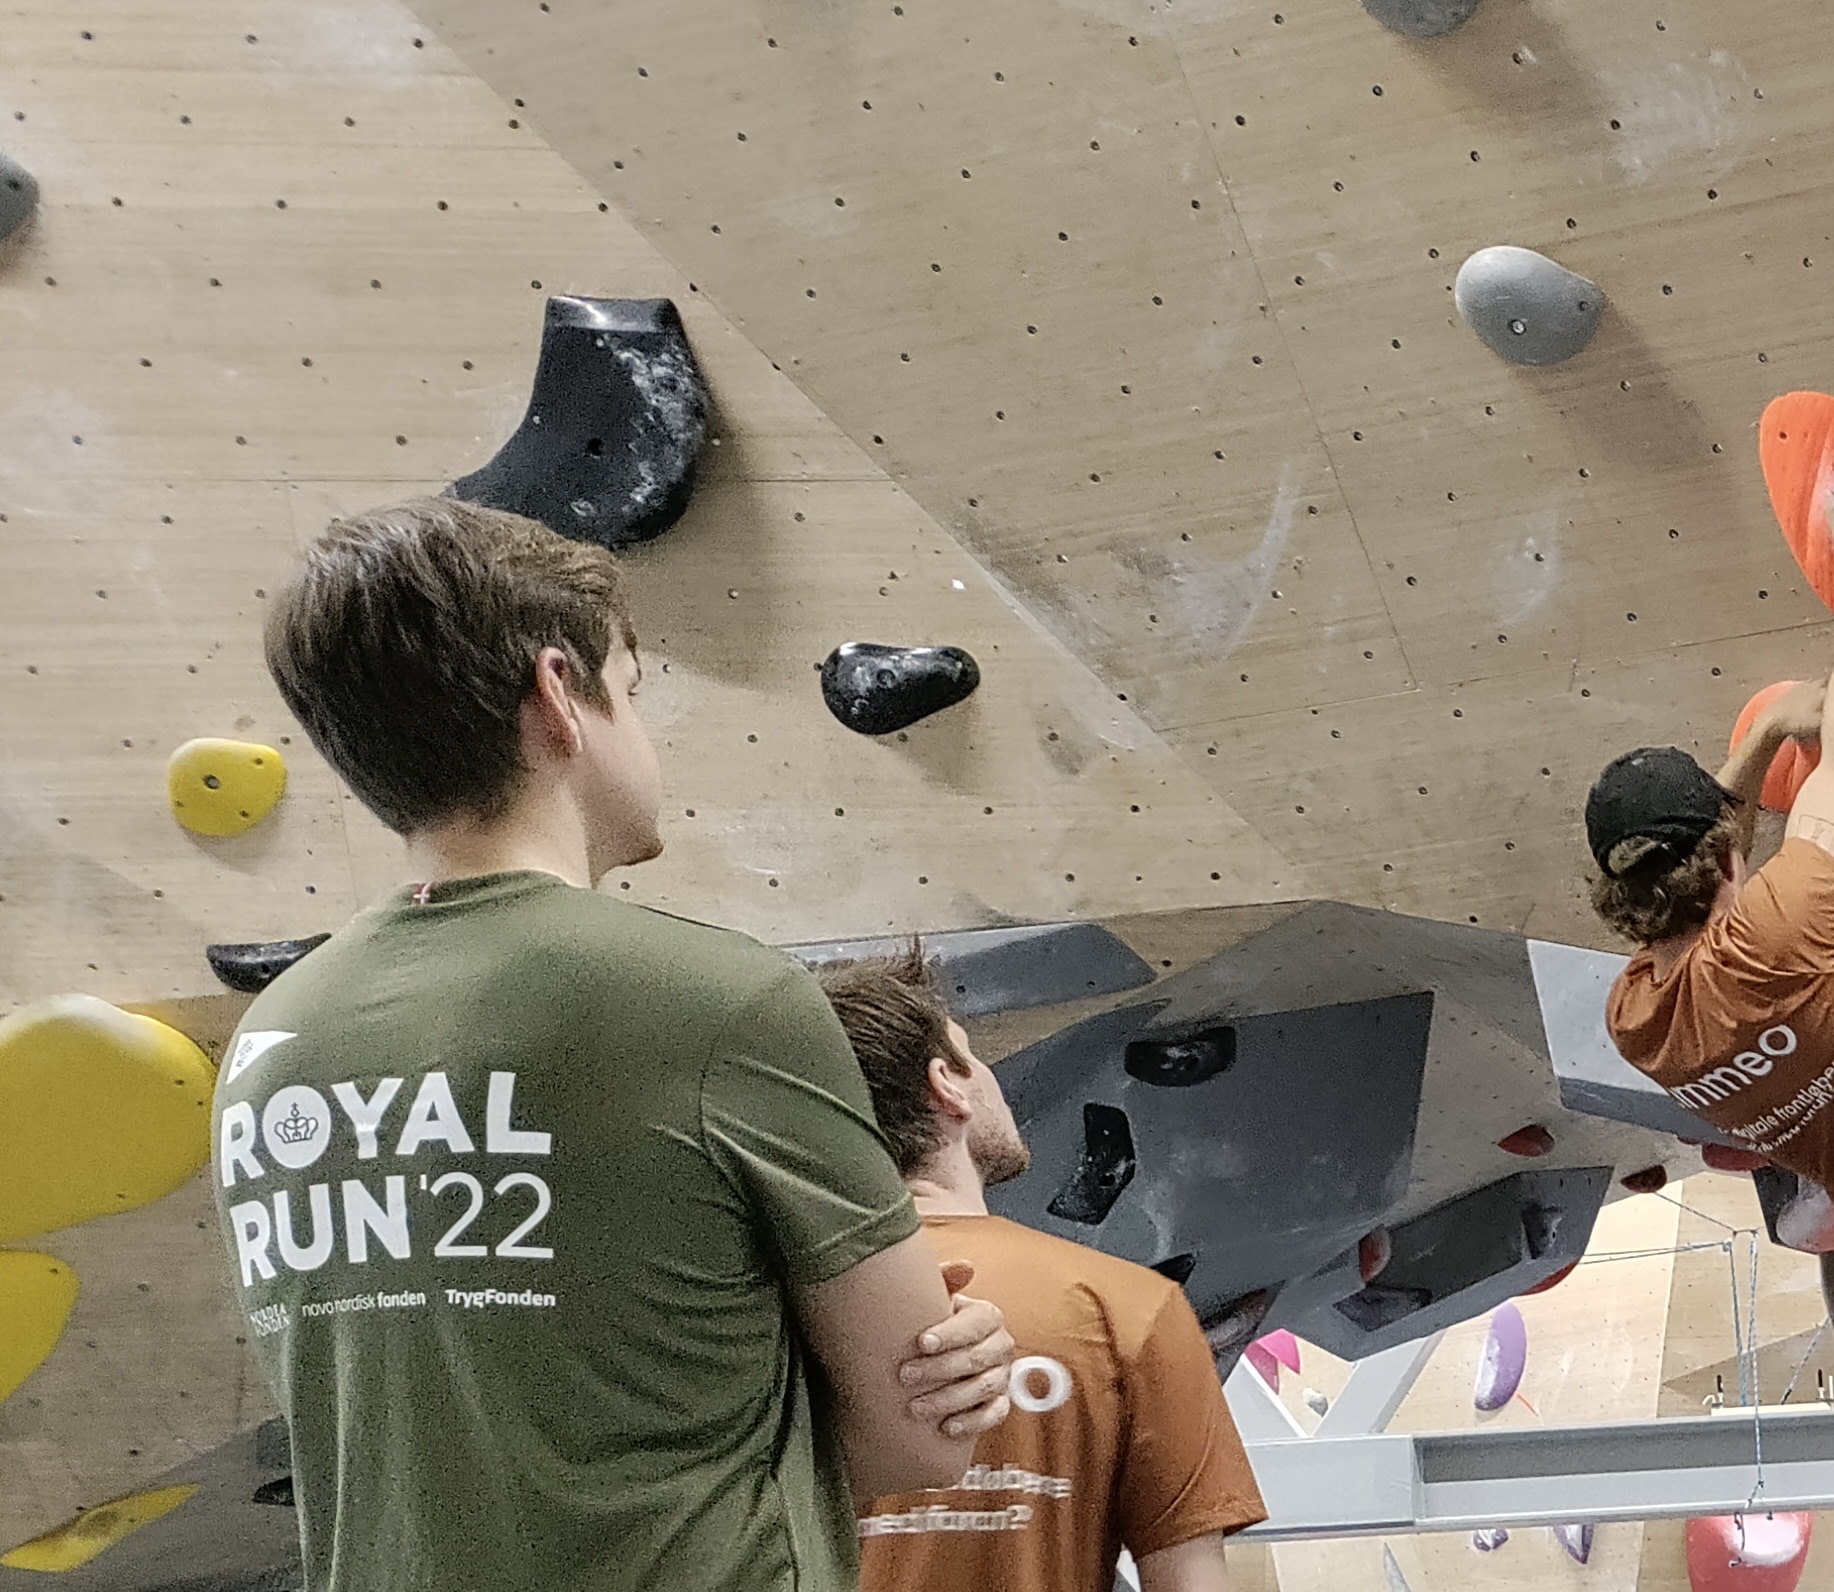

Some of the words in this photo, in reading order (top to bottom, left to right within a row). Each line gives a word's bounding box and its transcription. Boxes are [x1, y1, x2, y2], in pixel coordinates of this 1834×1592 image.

[220, 1071, 551, 1188] ROYAL
[376, 1290, 427, 1309] fonden
[444, 1288, 557, 1309] TrygFonden
